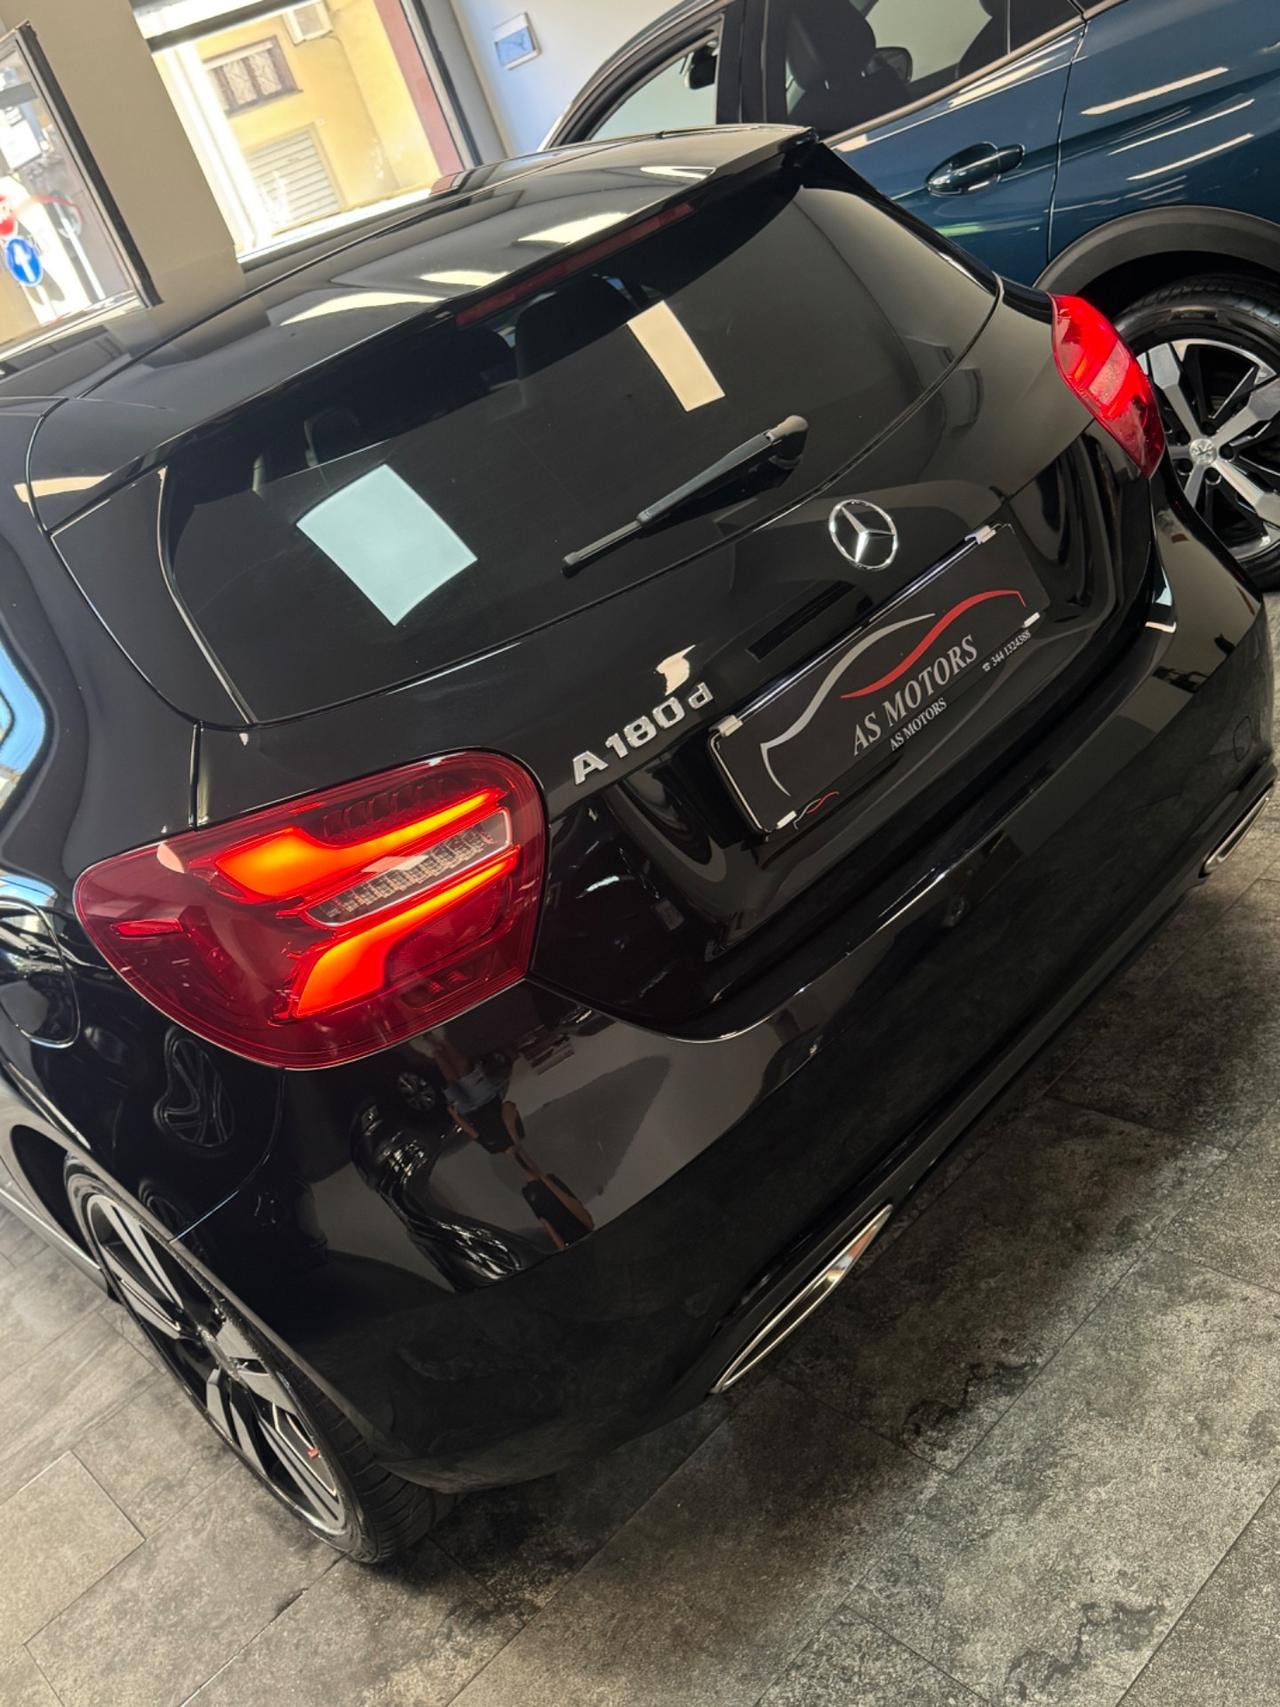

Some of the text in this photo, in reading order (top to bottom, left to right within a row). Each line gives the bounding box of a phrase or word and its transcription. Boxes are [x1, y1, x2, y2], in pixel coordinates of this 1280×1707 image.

[991, 650, 1005, 667] 344
[853, 634, 978, 756] AS MOTORS
[888, 697, 948, 752] AS MOTORS
